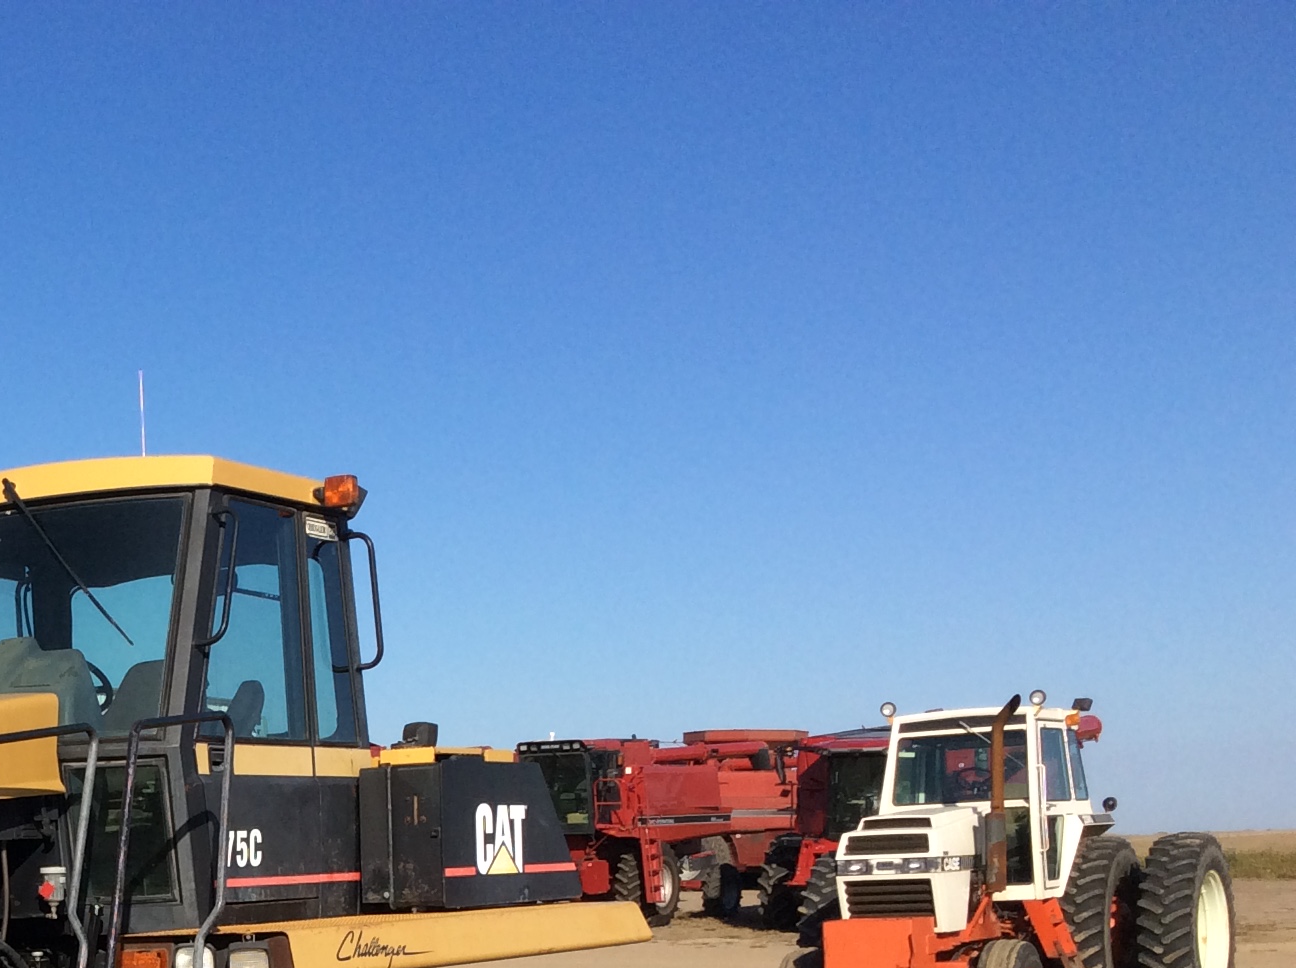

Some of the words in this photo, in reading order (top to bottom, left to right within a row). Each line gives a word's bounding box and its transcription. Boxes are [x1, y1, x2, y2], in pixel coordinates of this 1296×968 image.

[475, 802, 526, 875] CAT
[943, 856, 961, 871] CASE
[336, 930, 434, 968] Challenger
